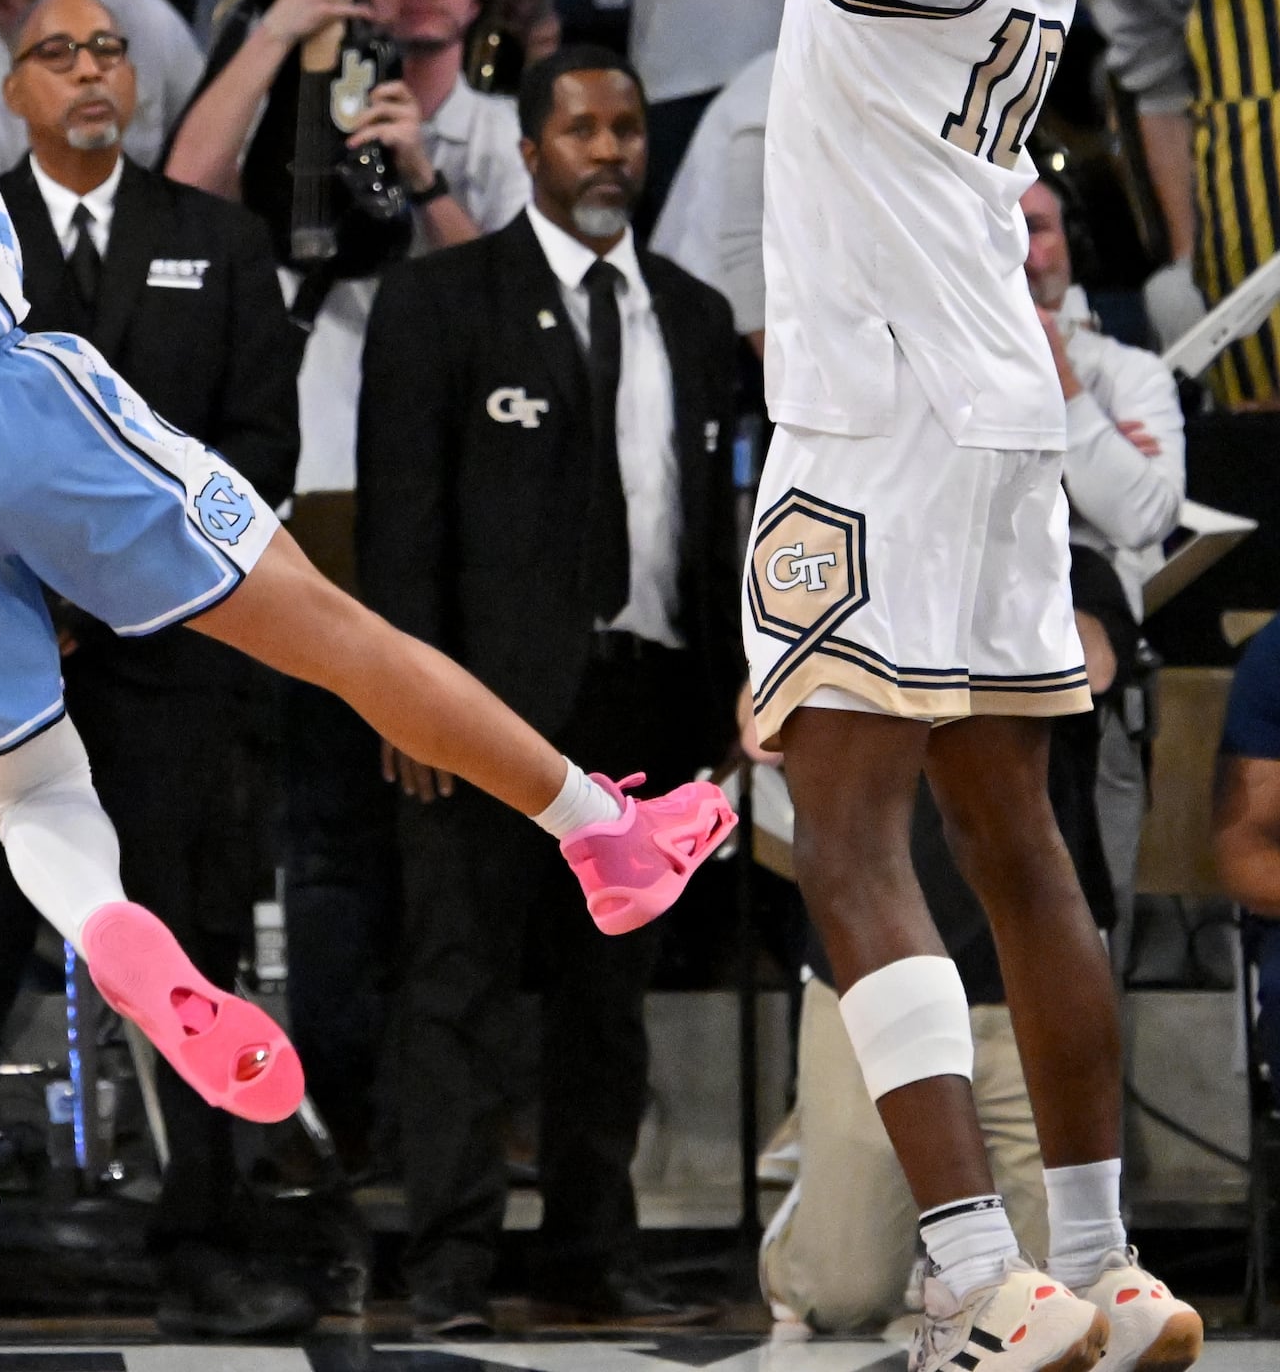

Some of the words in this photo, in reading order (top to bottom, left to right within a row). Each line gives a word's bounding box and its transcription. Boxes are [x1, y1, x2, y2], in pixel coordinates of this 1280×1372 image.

[940, 8, 1067, 171] 10
[486, 386, 550, 428] GT
[766, 543, 837, 593] GT
